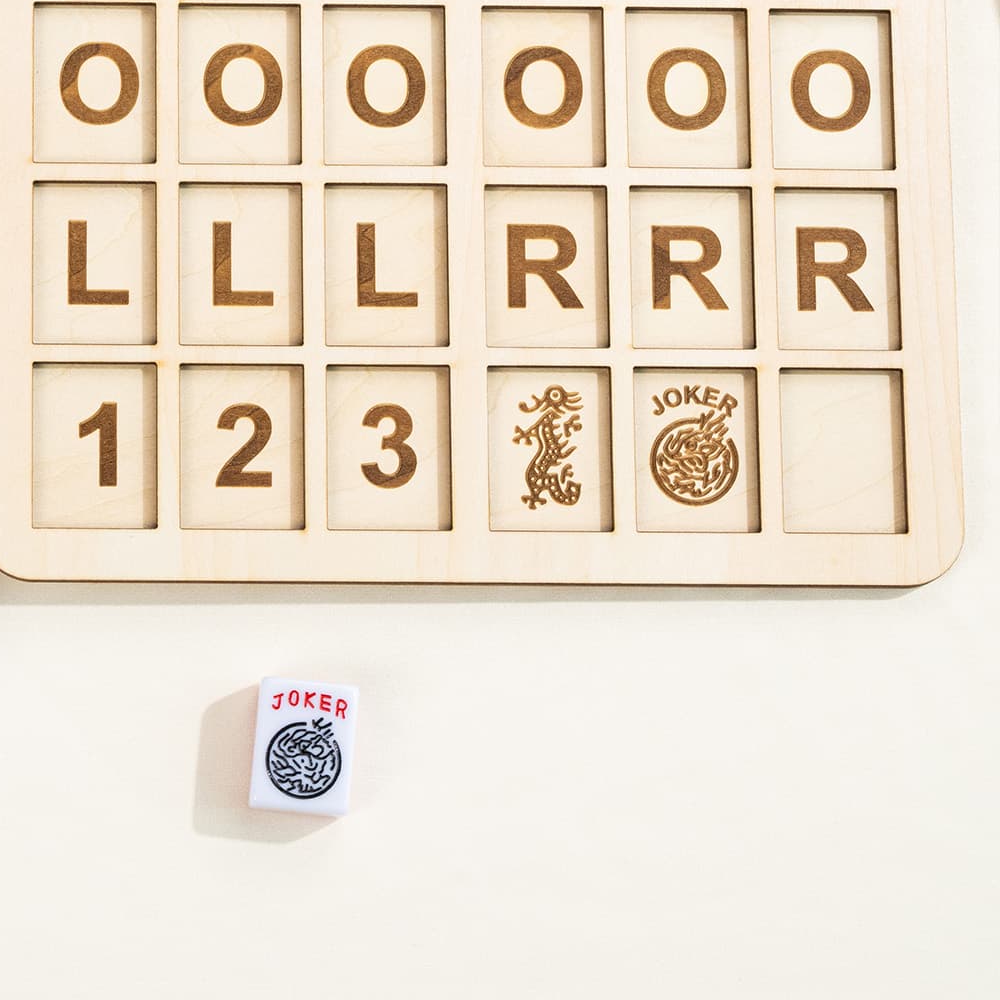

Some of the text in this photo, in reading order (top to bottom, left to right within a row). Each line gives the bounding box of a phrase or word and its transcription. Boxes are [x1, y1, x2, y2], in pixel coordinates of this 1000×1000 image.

[59, 42, 871, 132] O O O O O O
[67, 220, 875, 312] L L L R R R
[651, 384, 738, 417] JOKER
[78, 402, 418, 489] 1 2 3
[271, 689, 348, 720] JOKER
